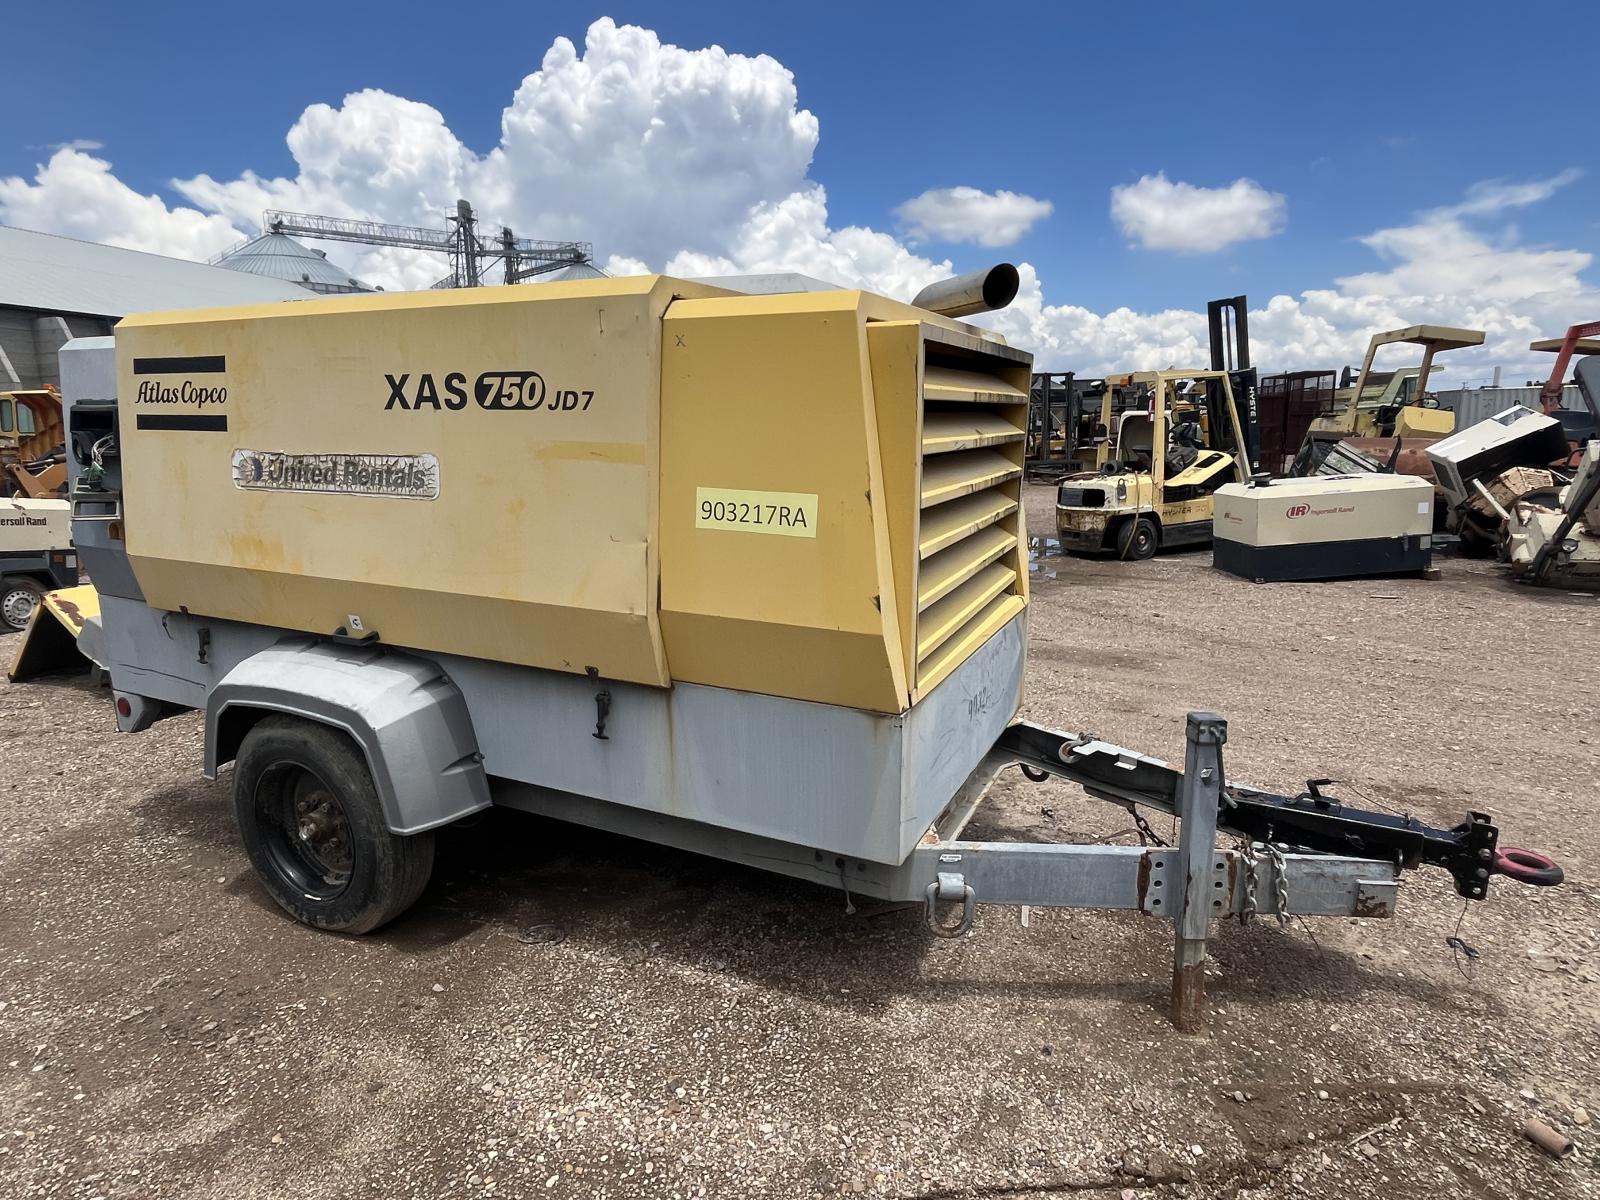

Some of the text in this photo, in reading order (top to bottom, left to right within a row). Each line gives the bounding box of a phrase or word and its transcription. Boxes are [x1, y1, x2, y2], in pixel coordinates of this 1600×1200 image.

[135, 380, 227, 408] Atlas Copco
[384, 373, 595, 412] XAS 750 JD7
[1249, 386, 1257, 424] HYSTE
[269, 458, 426, 489] United Rentals
[26, 517, 47, 526] Rand
[701, 500, 807, 528] 903217RA
[1290, 505, 1307, 517] IR
